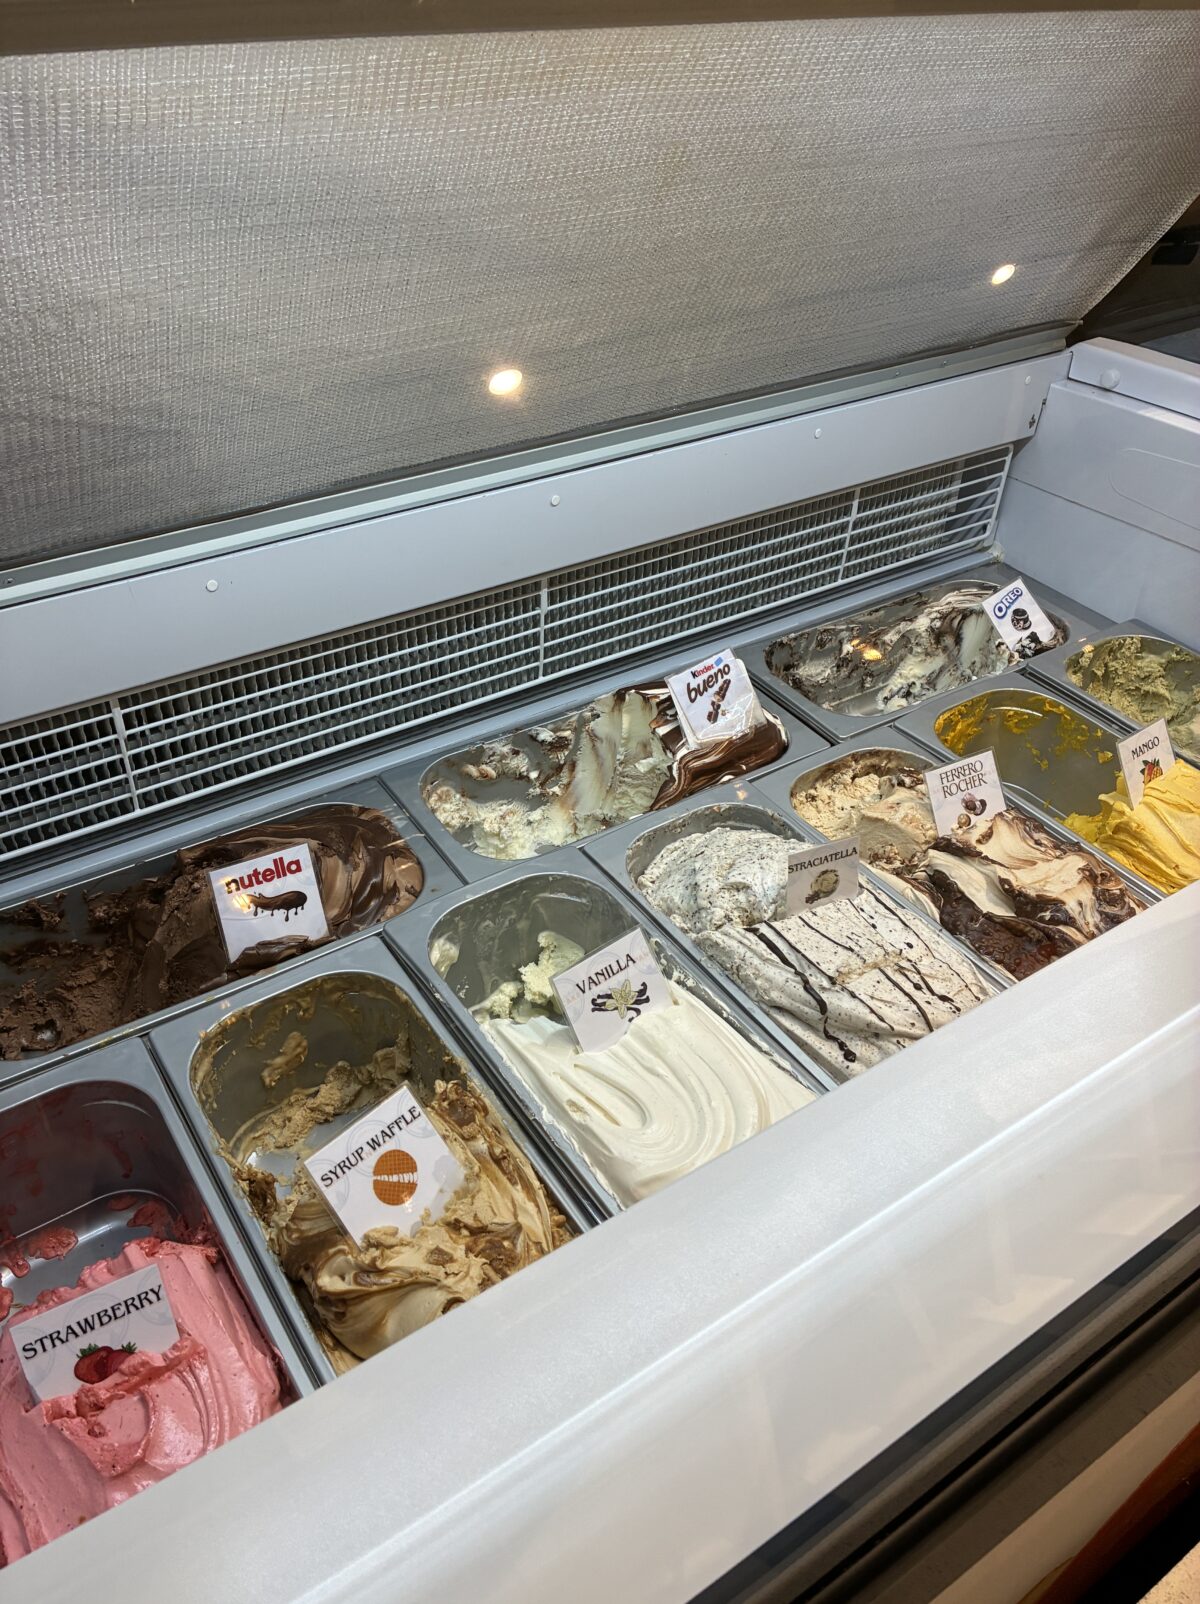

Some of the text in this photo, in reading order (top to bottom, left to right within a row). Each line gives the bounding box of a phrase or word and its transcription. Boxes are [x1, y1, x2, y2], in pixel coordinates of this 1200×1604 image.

[993, 587, 1023, 619] OREO
[686, 663, 731, 703] bueno
[1131, 736, 1160, 760] MANGO
[939, 760, 984, 785] FERRERO
[942, 772, 988, 798] ROCHER
[225, 856, 302, 894] nutella
[788, 846, 858, 874] STRACIATELLA
[575, 953, 636, 994] VANILLA
[320, 1146, 364, 1188] SYRUP
[366, 1105, 421, 1152] WAFFLE
[22, 1284, 162, 1361] STRAWBERRY
